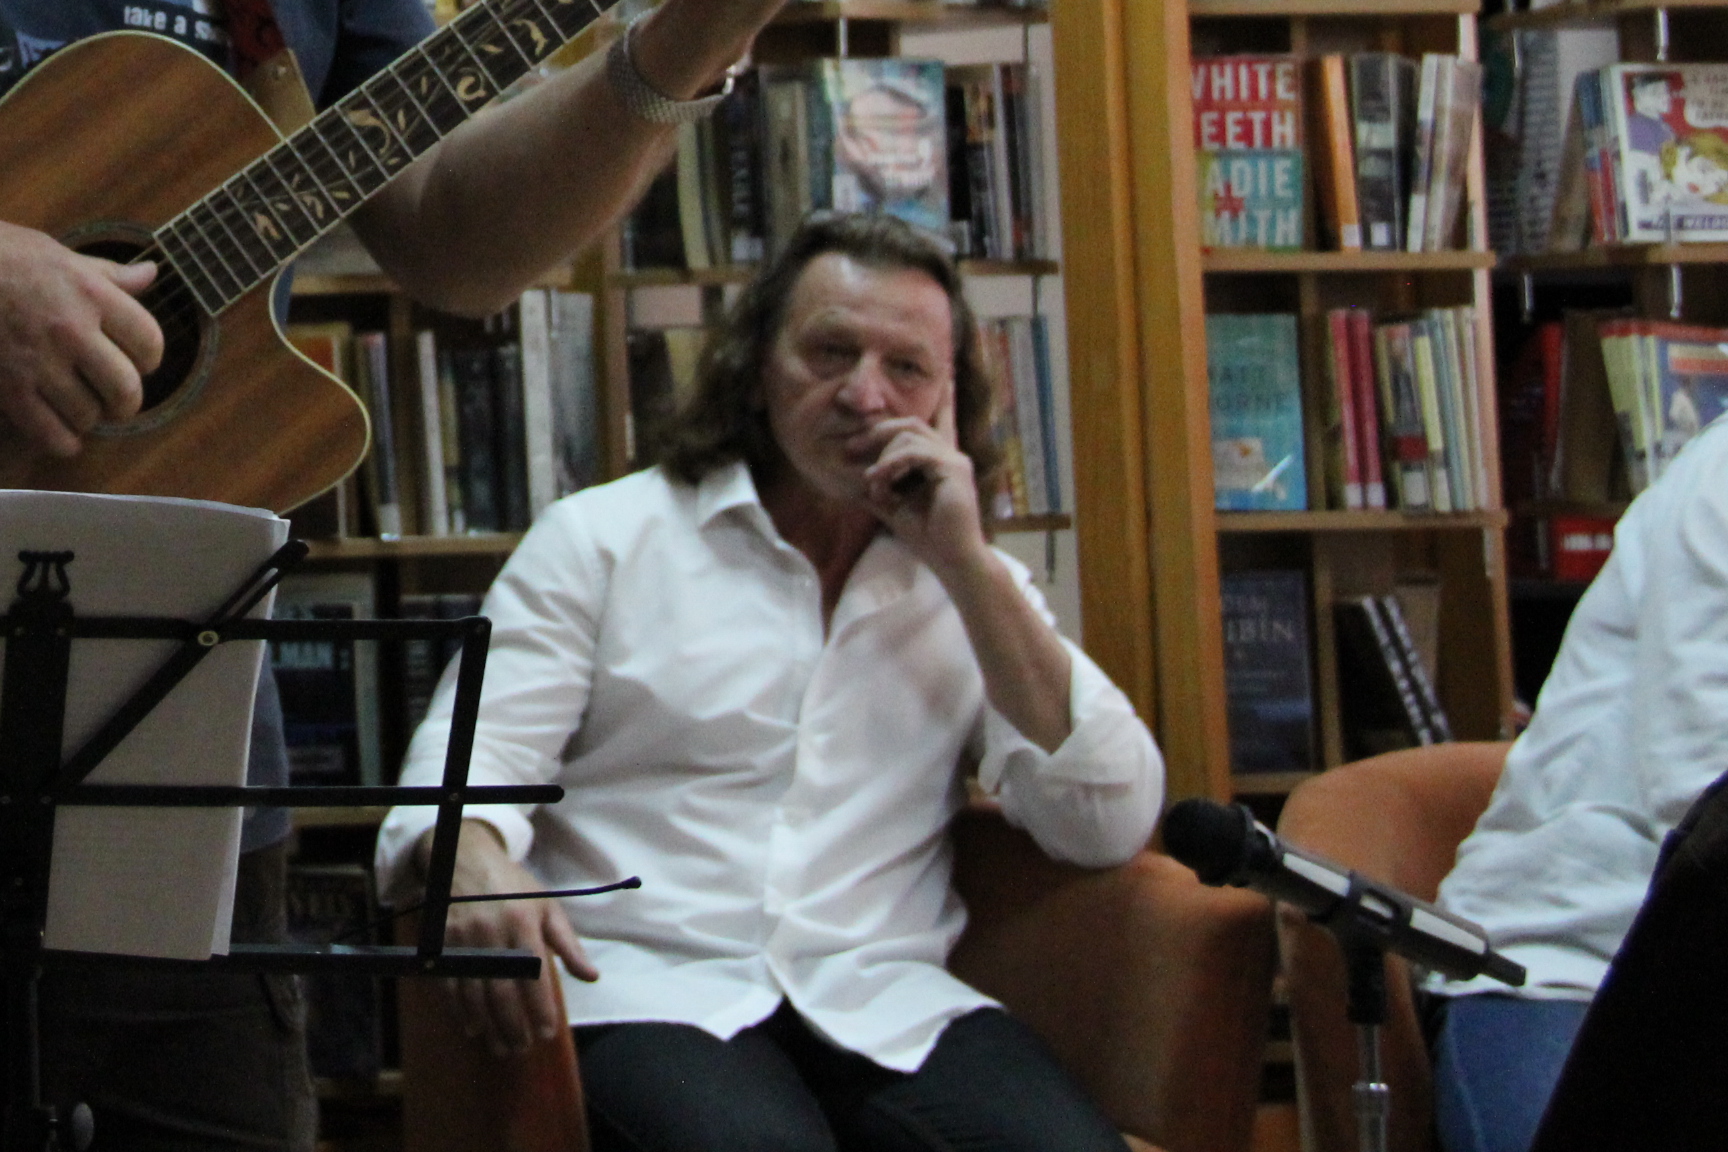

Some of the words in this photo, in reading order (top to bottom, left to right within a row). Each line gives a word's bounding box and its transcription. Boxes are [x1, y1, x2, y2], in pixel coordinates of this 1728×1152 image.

[174, 14, 188, 36] a
[1200, 110, 1296, 149] EETH
[1204, 158, 1293, 199] ADIE
[1203, 207, 1299, 247] MITH
